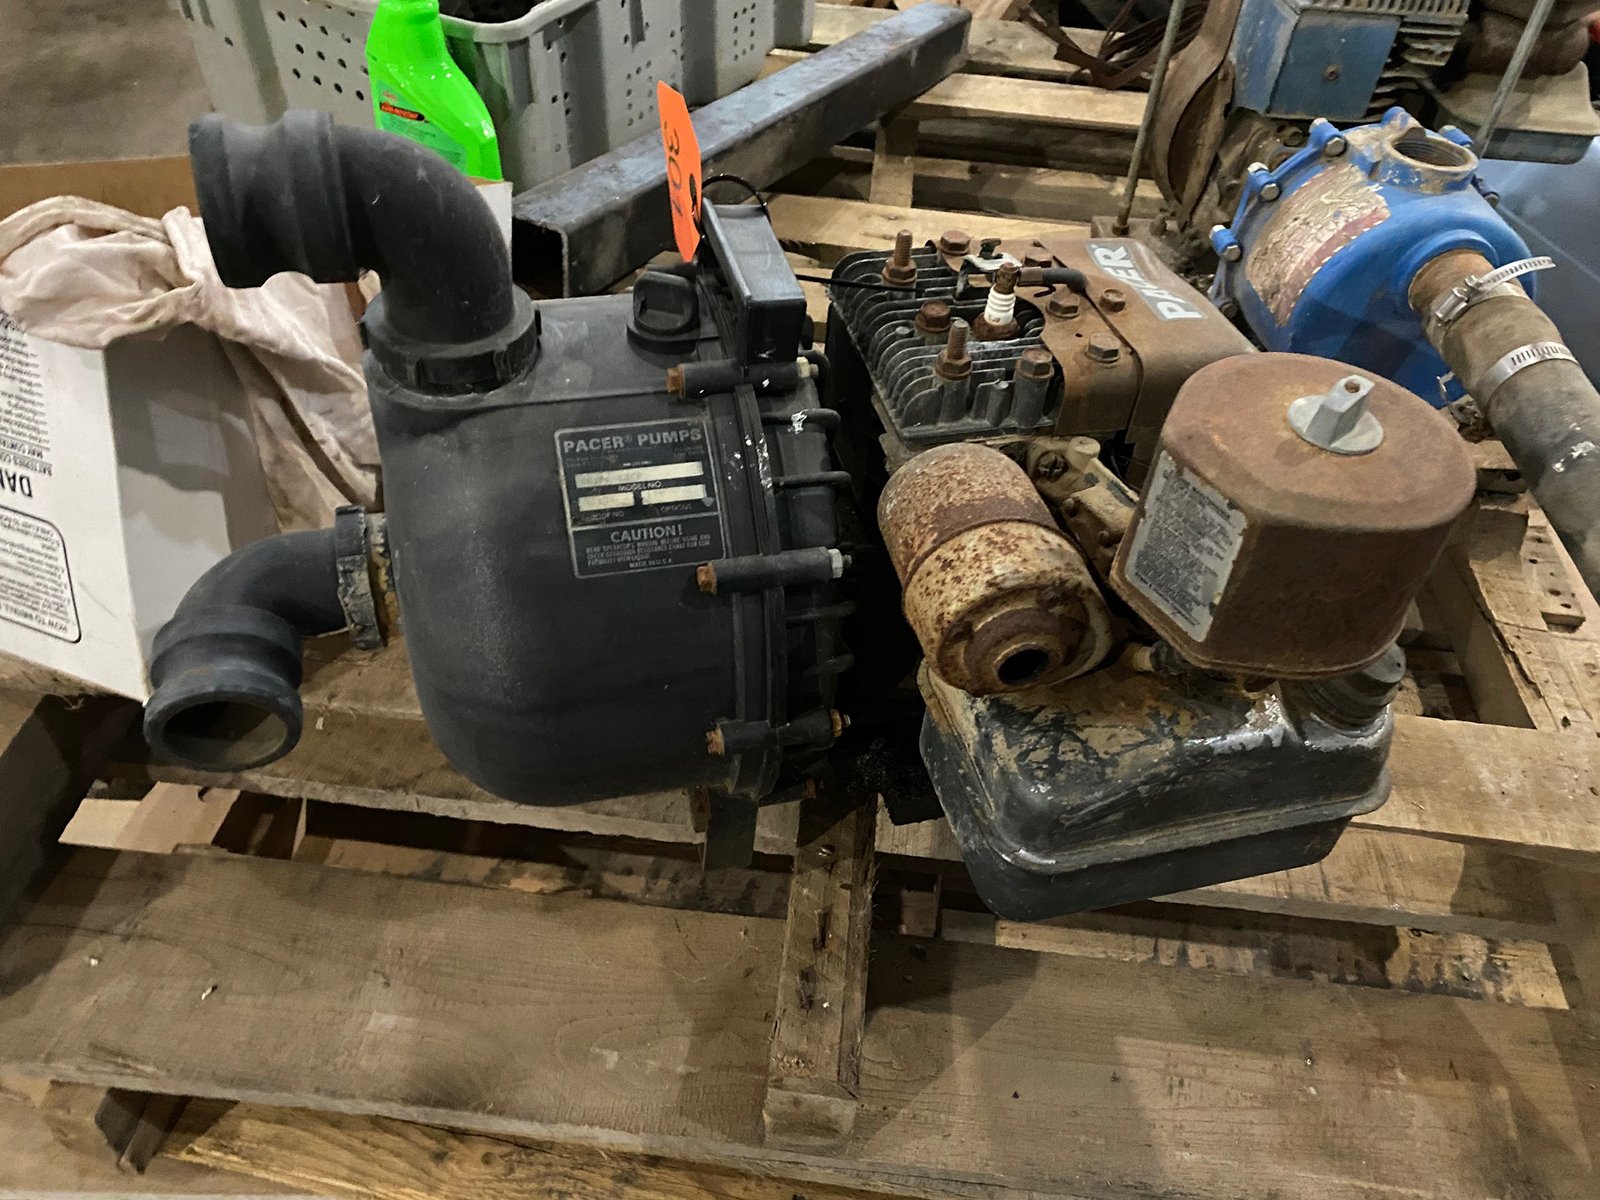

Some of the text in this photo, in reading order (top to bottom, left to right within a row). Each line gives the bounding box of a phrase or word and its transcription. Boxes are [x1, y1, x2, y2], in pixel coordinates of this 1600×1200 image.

[637, 429, 702, 447] PUMPS
[618, 482, 645, 491] MODEL
[610, 523, 682, 543] CAUTION!
